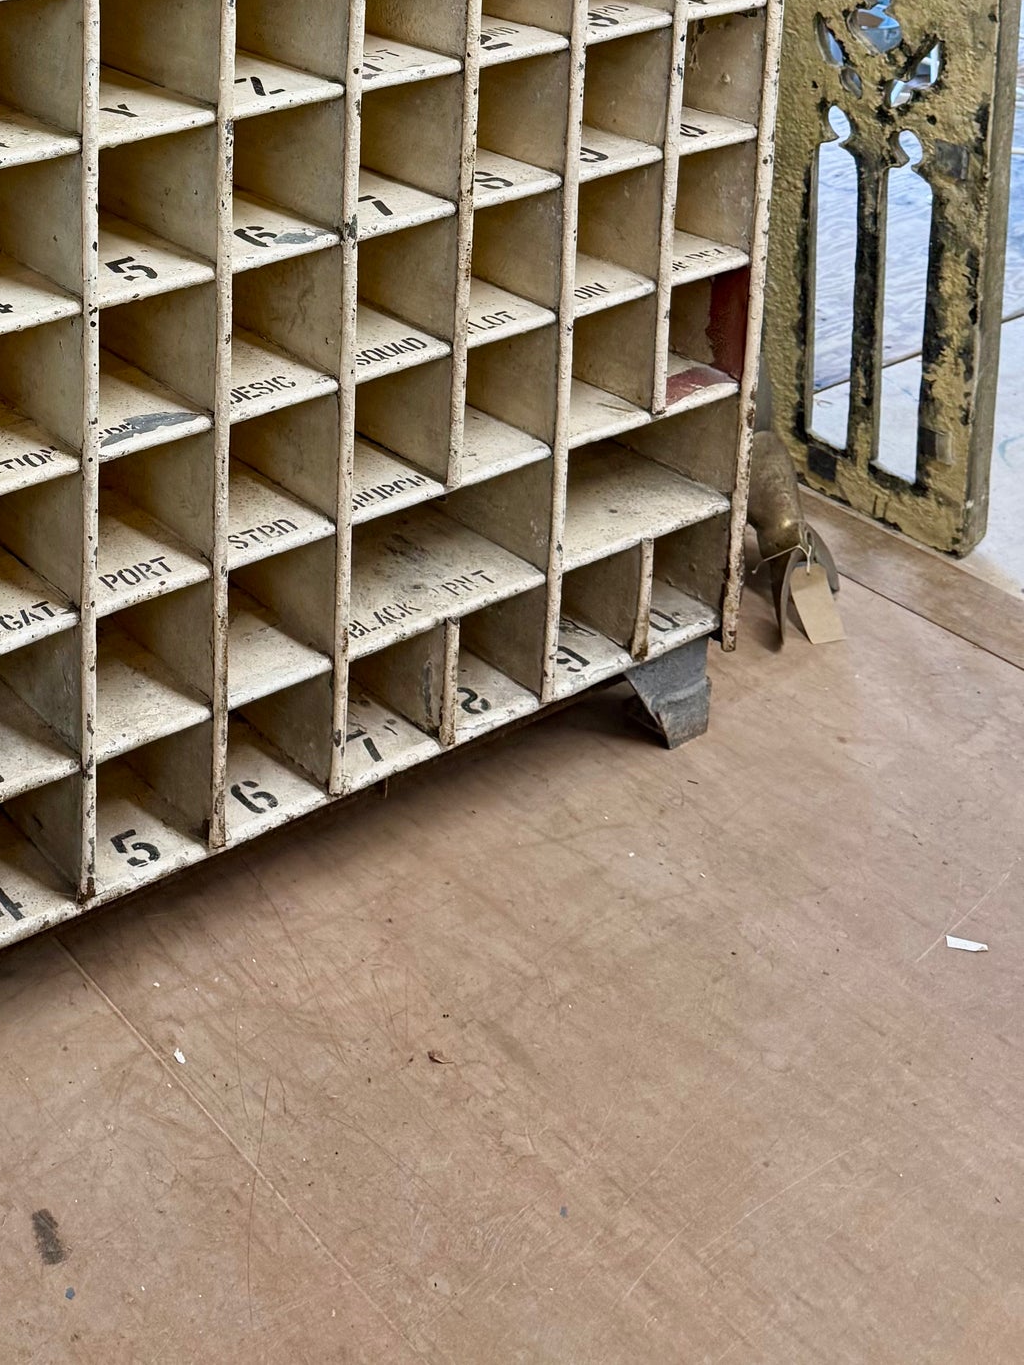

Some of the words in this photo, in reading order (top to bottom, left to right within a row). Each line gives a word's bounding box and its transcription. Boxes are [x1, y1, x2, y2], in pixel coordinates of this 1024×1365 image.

[233, 76, 286, 97] Z
[357, 195, 394, 216] 7
[233, 225, 278, 248] 6
[104, 256, 158, 280] 5
[356, 337, 428, 366] SQUAD
[352, 475, 426, 511] HURCH
[227, 517, 300, 550] STBD
[98, 555, 174, 592] PORT
[348, 602, 423, 639] BLACK
[344, 728, 383, 763] 7
[229, 779, 279, 815] 6
[109, 828, 162, 868] 5
